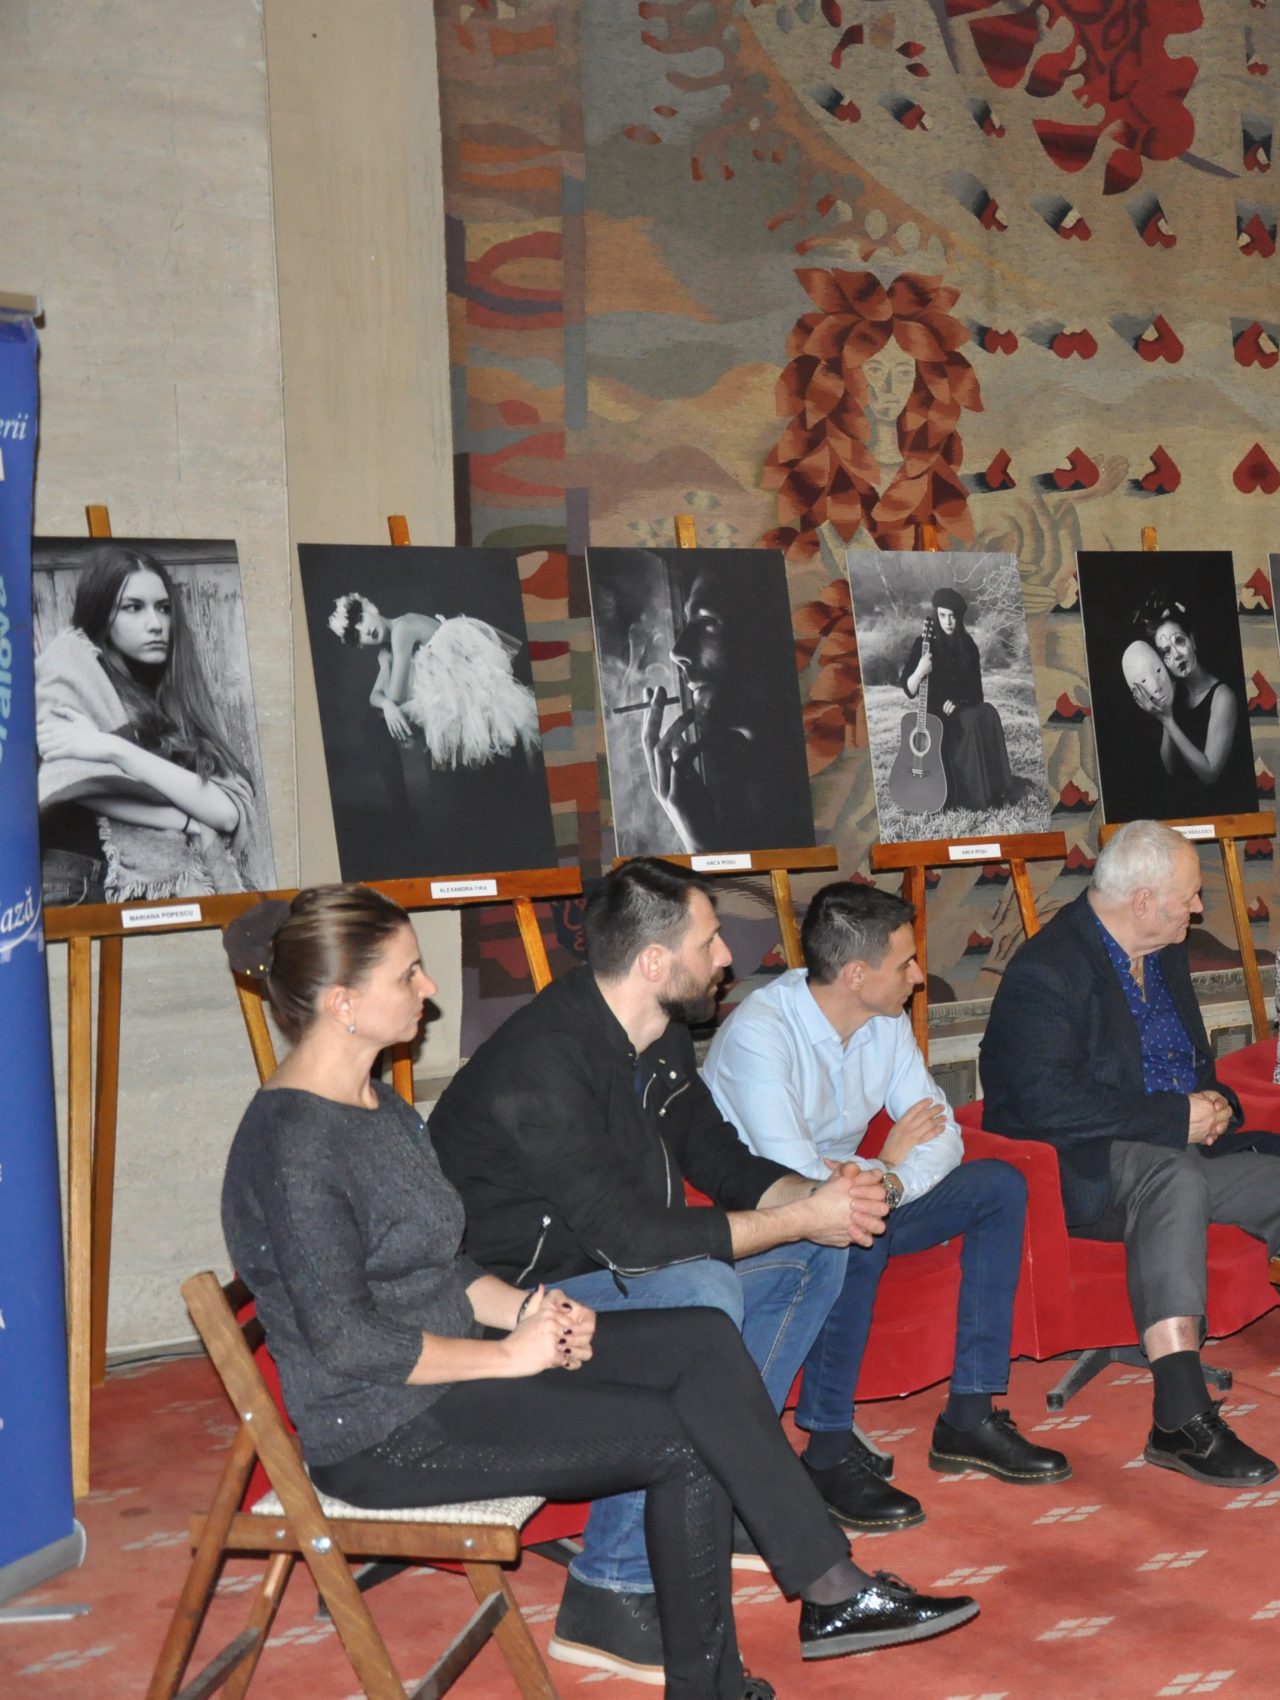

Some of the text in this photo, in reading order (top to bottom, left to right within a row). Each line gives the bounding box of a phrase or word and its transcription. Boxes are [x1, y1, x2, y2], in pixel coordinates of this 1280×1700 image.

[0, 412, 28, 440] rii
[0, 885, 34, 933] ază
[129, 909, 194, 921] MARIANA POPESCU
